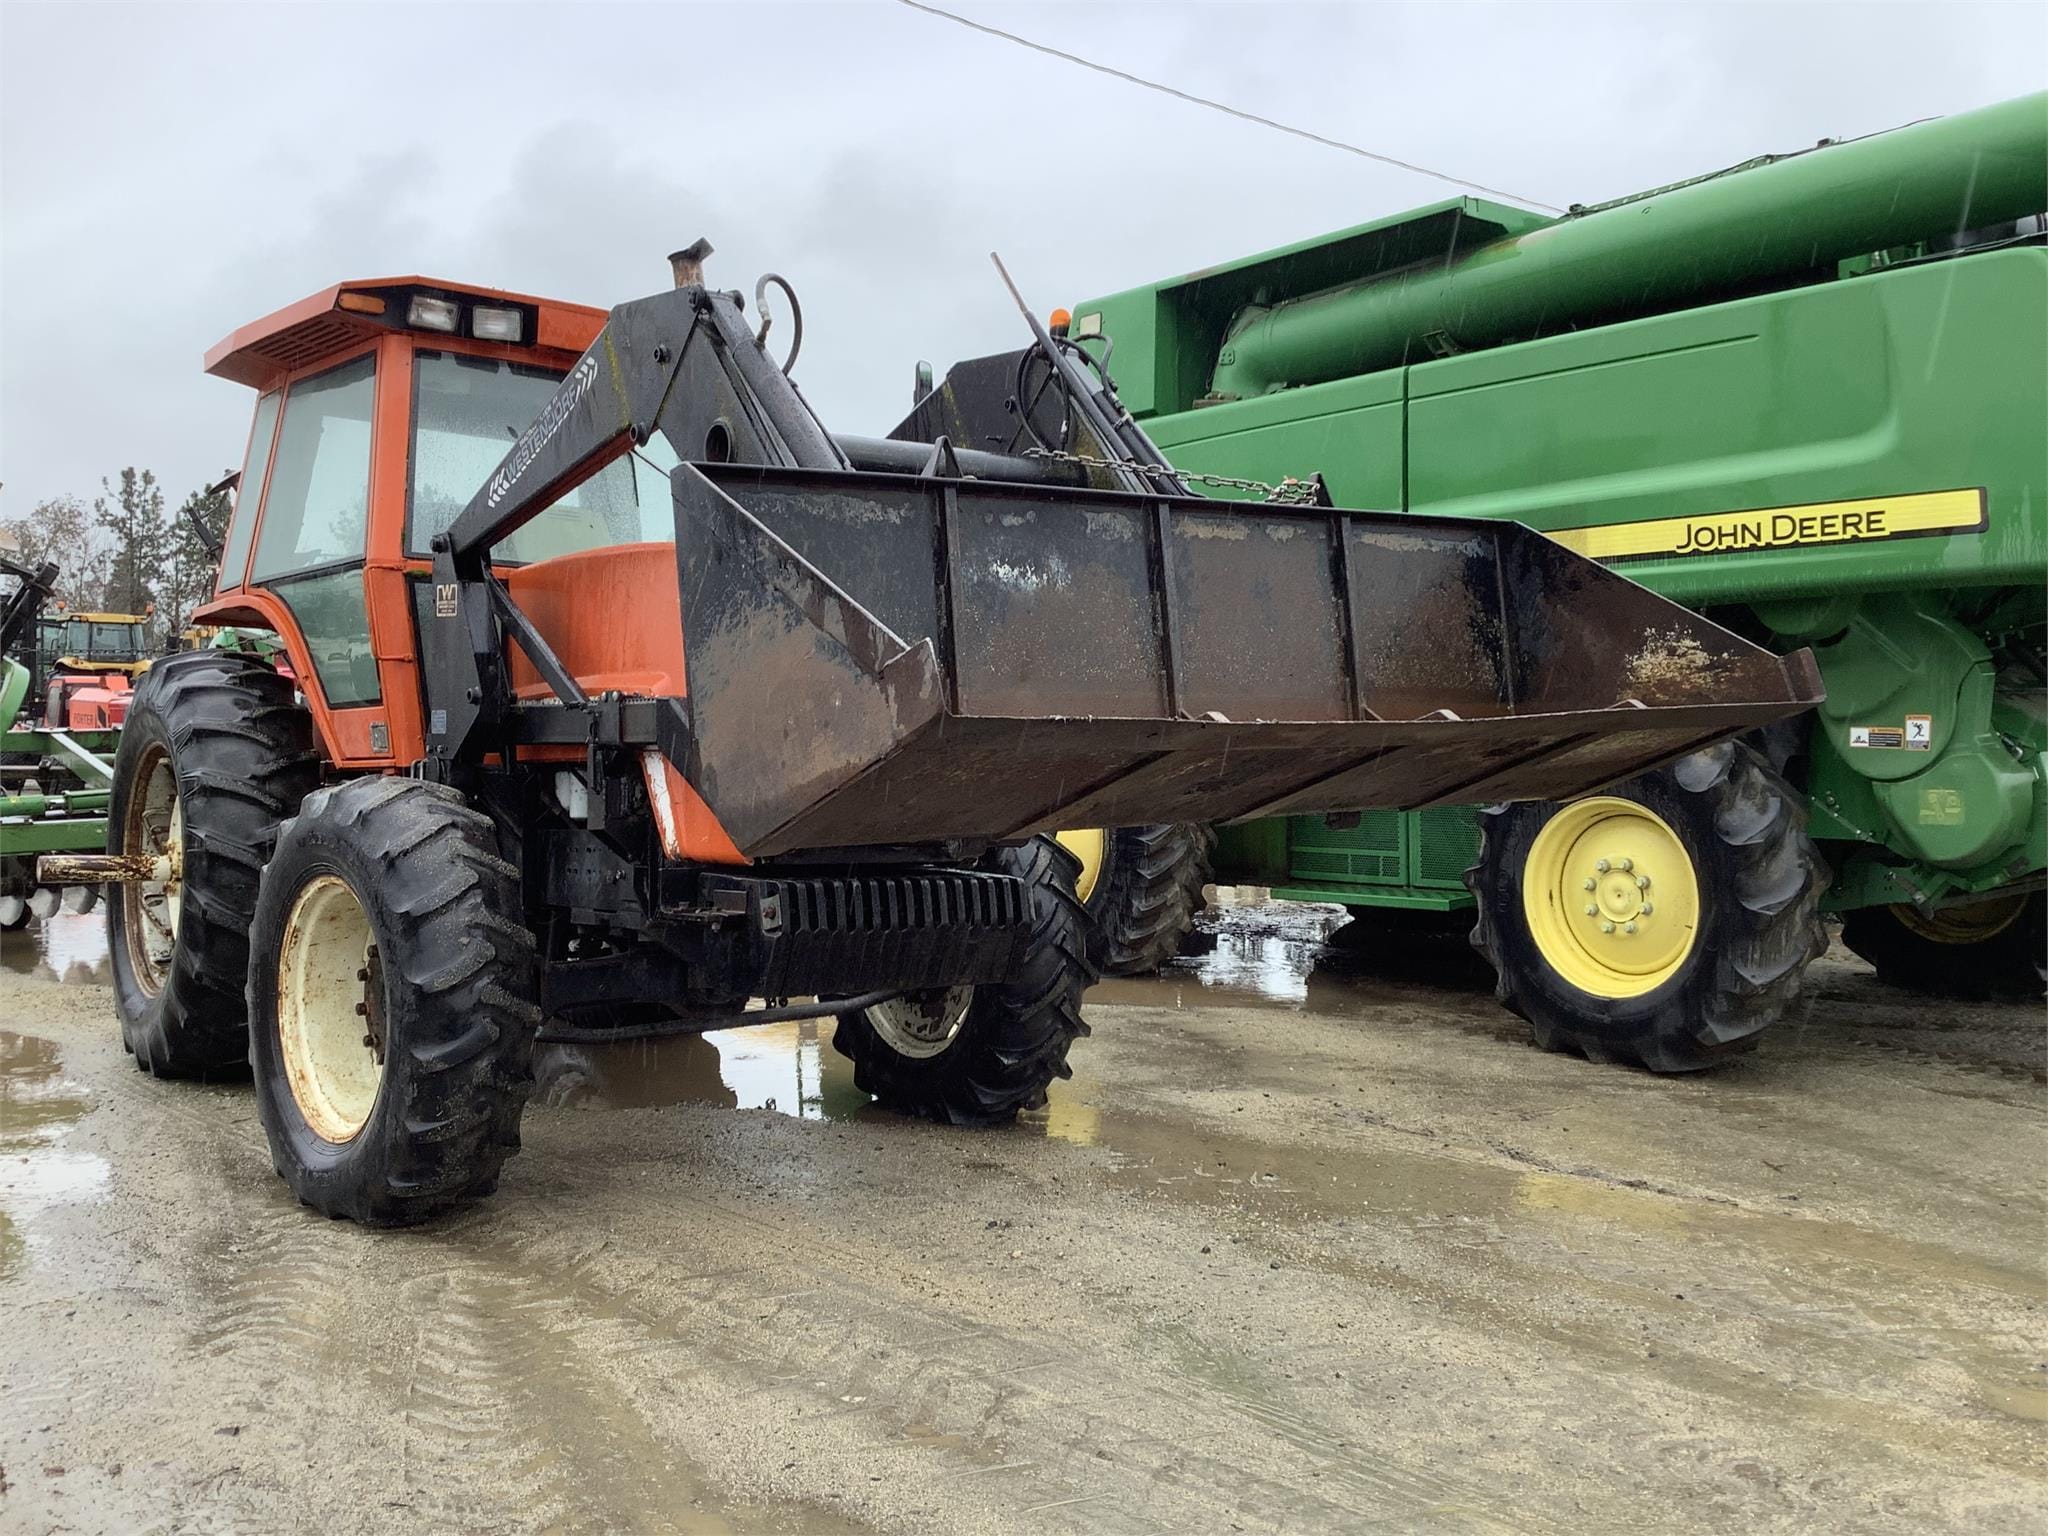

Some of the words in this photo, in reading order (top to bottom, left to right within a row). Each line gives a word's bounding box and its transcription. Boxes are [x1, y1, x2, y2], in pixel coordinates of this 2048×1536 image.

[505, 384, 577, 481] WESTENDORF
[1676, 522, 1762, 550] JOHN
[1771, 510, 1886, 542] DEERE
